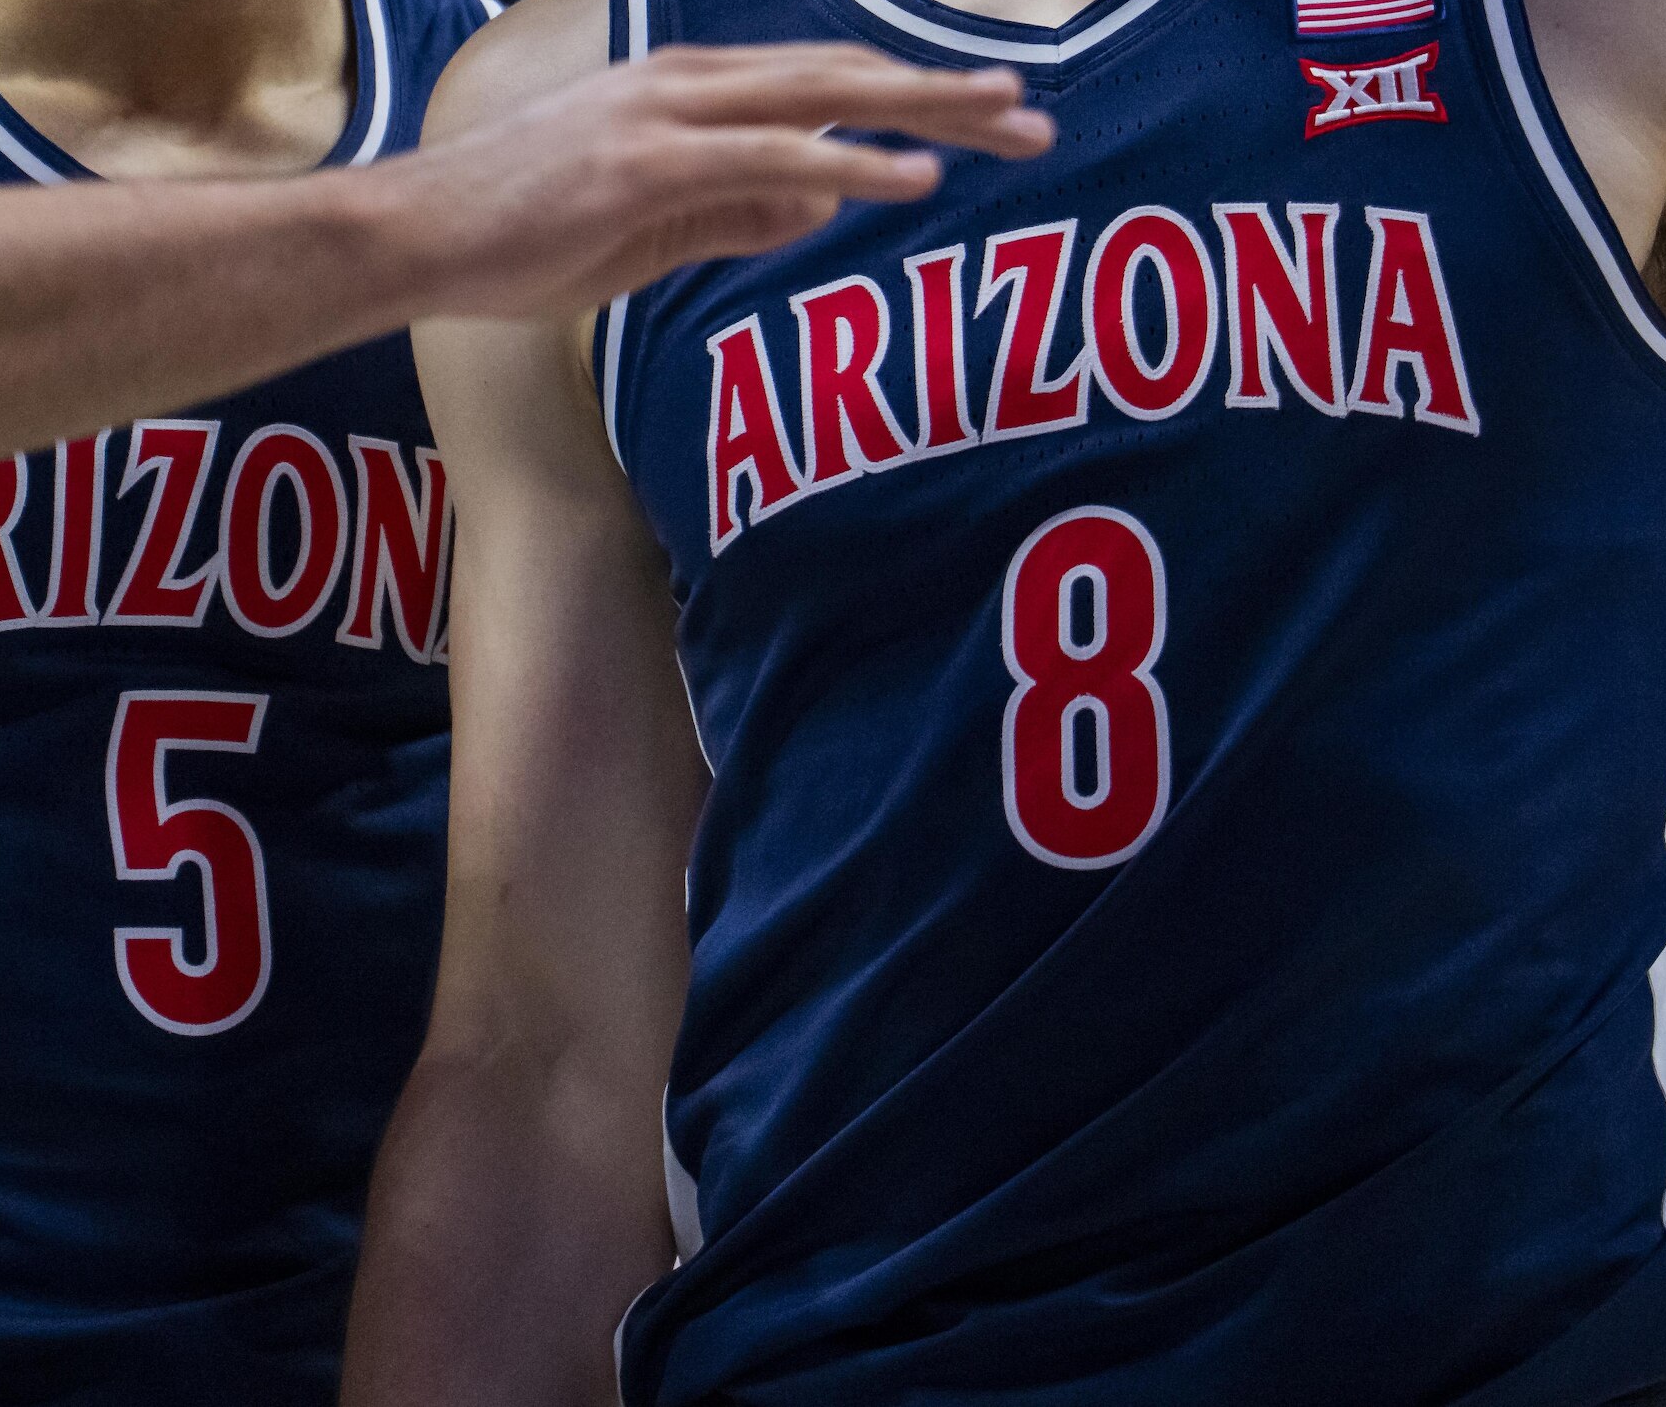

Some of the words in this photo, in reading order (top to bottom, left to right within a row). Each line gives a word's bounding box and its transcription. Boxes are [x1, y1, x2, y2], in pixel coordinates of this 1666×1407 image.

[1309, 52, 1435, 126] XII
[707, 201, 1481, 557] ARIZONA
[105, 689, 271, 1036] 5
[1001, 504, 1171, 870] 8
